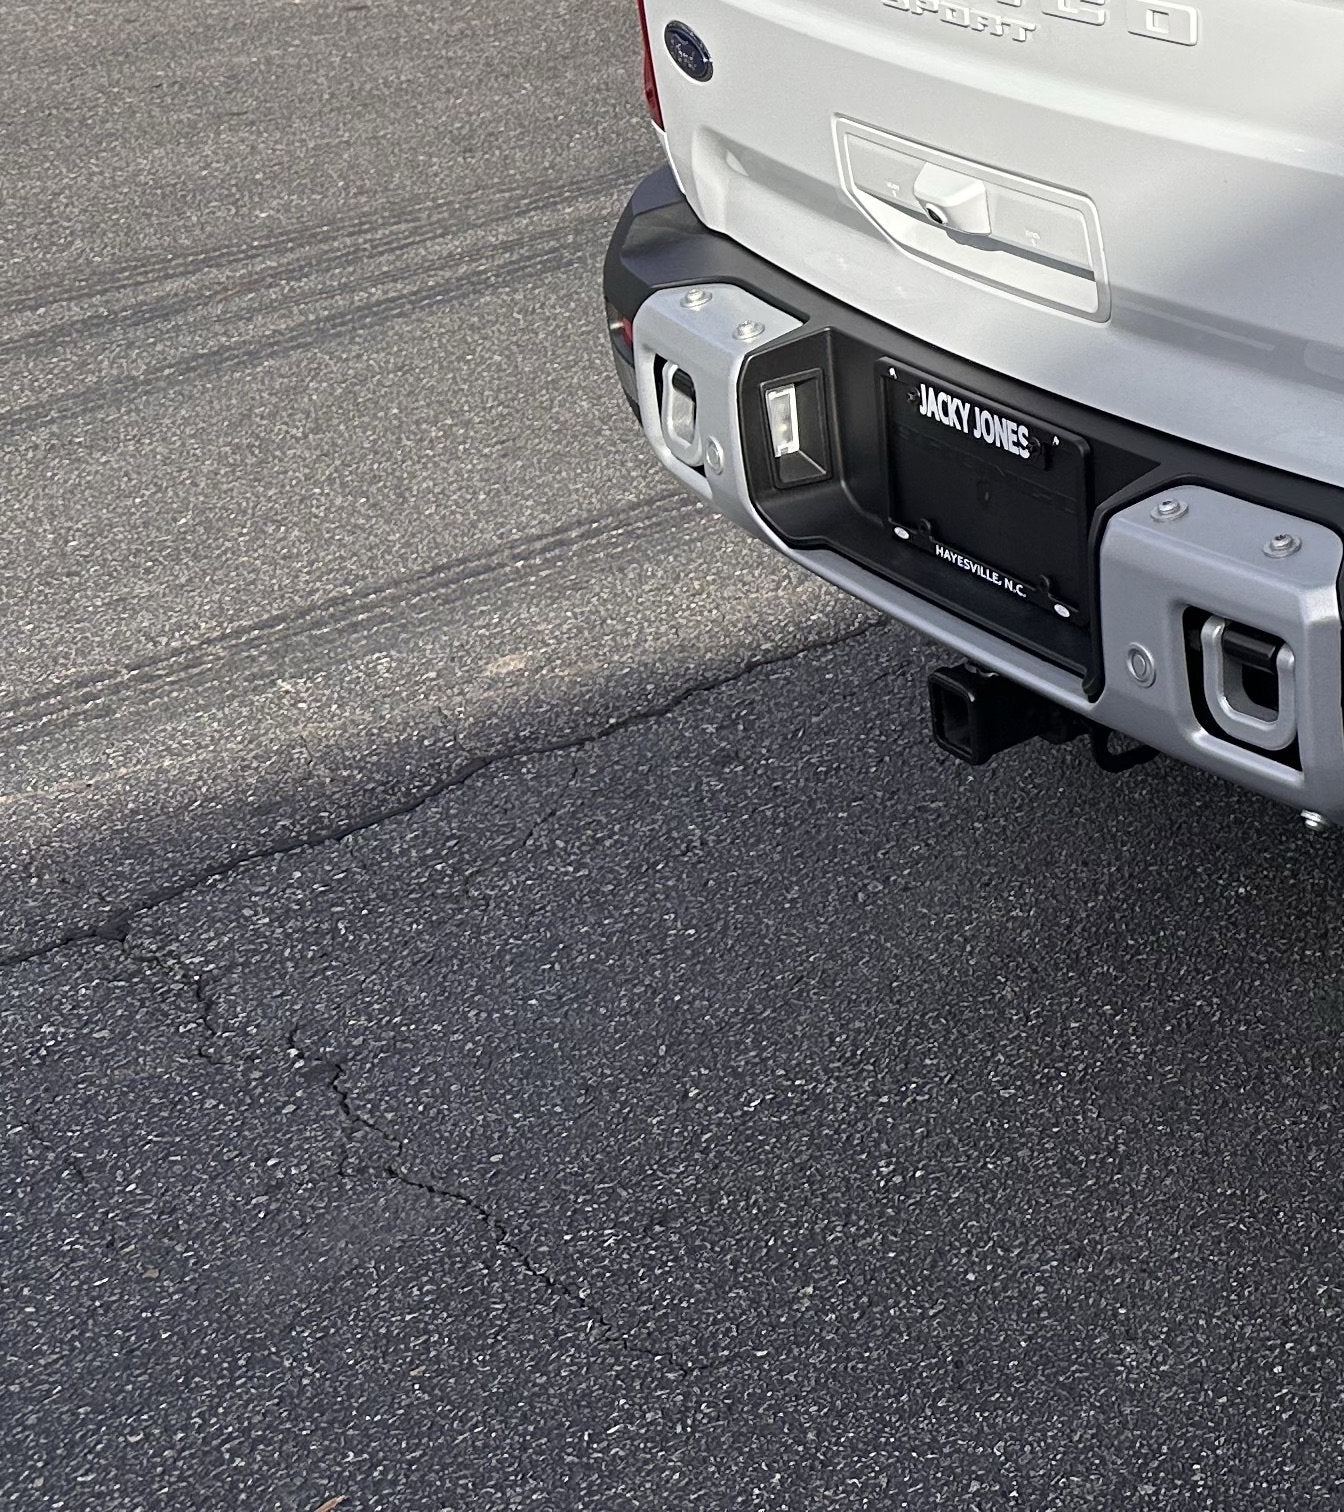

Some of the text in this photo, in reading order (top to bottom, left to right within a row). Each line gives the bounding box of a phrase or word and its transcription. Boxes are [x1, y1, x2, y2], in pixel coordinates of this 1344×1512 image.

[919, 383, 1031, 459] JACKY JONES
[1004, 577, 1027, 598] N.C.
